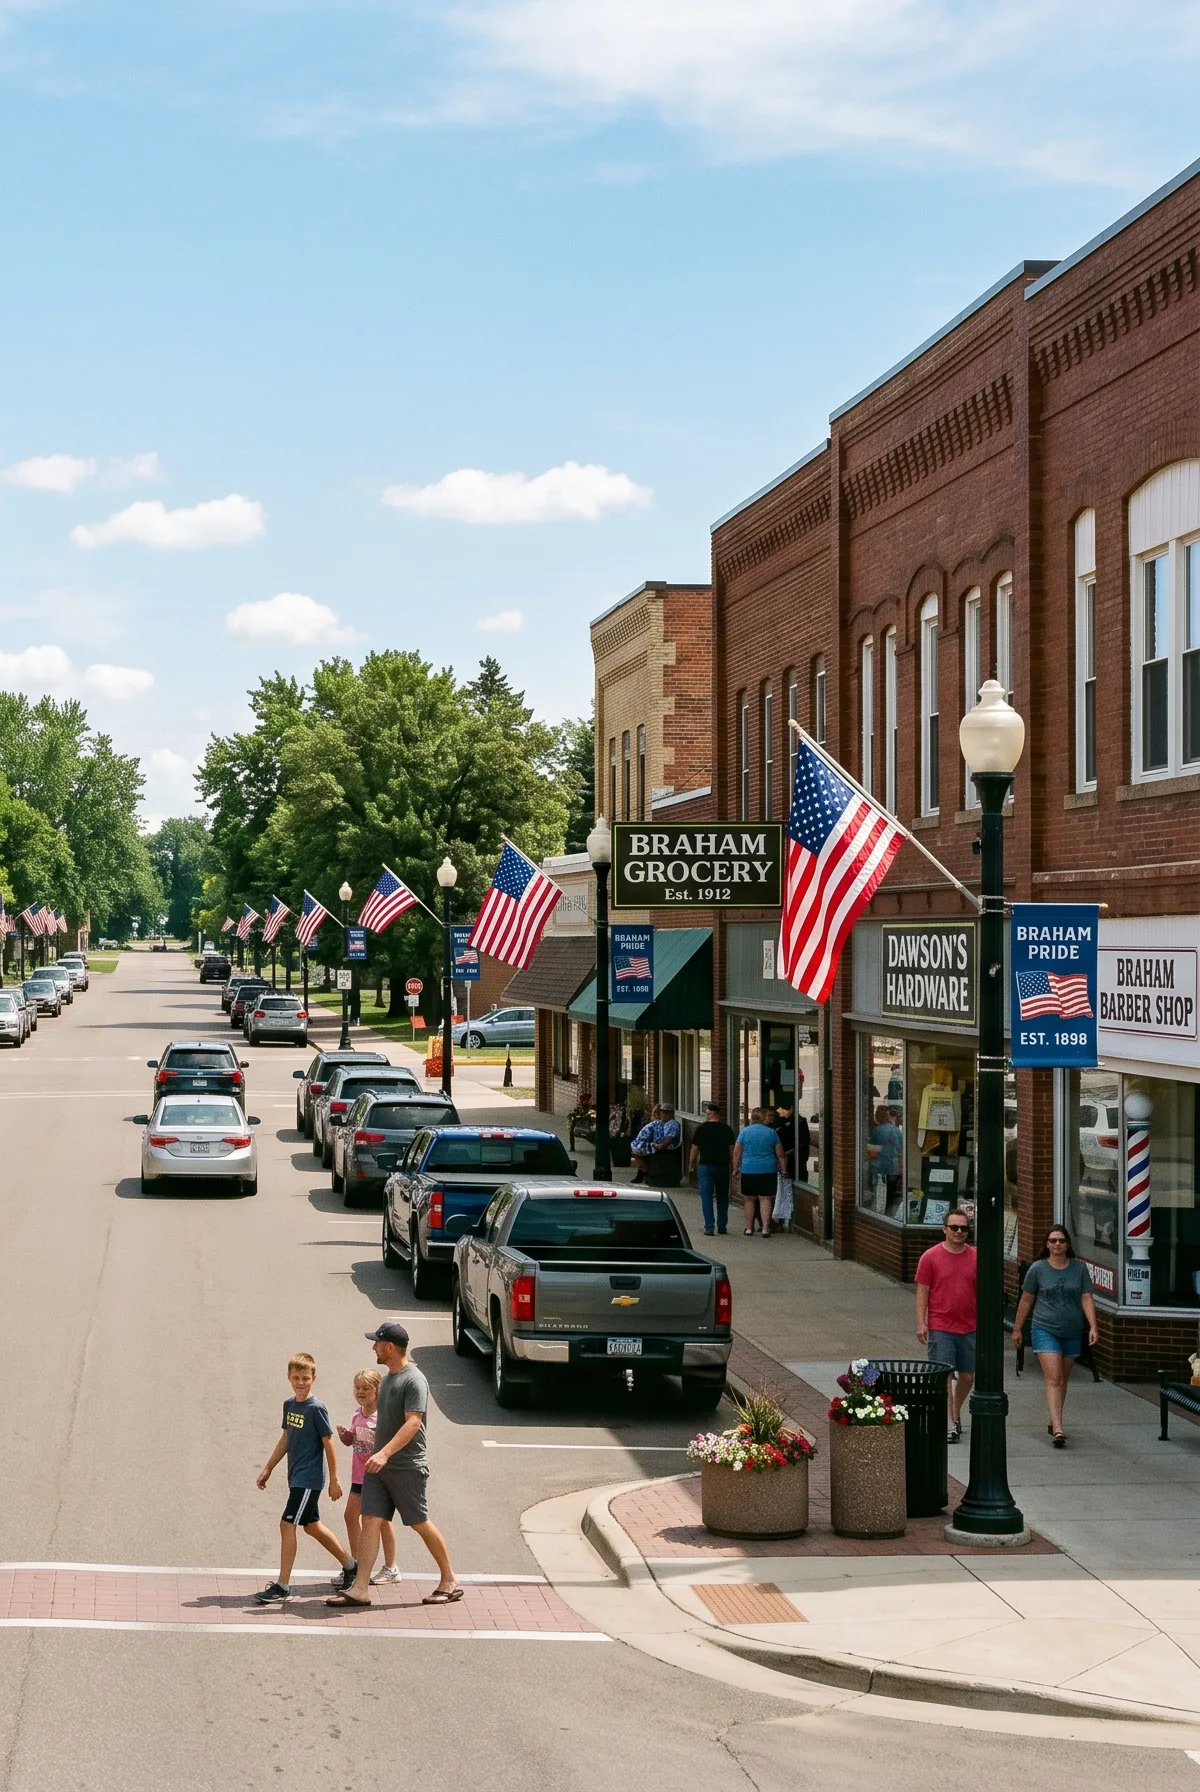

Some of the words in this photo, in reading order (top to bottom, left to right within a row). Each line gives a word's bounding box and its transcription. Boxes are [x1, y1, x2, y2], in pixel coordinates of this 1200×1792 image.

[629, 834, 766, 855] BRAHAM
[624, 861, 773, 882] GROCERY
[665, 889, 692, 900] Est.
[698, 889, 730, 899] 1912
[1017, 927, 1091, 940] BRAHAM
[888, 934, 967, 970] DAWSON'S
[1029, 945, 1079, 959] PRIDE
[1117, 959, 1174, 989] BRAHAM
[886, 974, 969, 1012] HARDWARE
[1101, 992, 1151, 1023] BARBER
[1156, 995, 1193, 1026] SHOP
[1021, 1033, 1049, 1045] EST.
[1055, 1033, 1087, 1045] 1898
